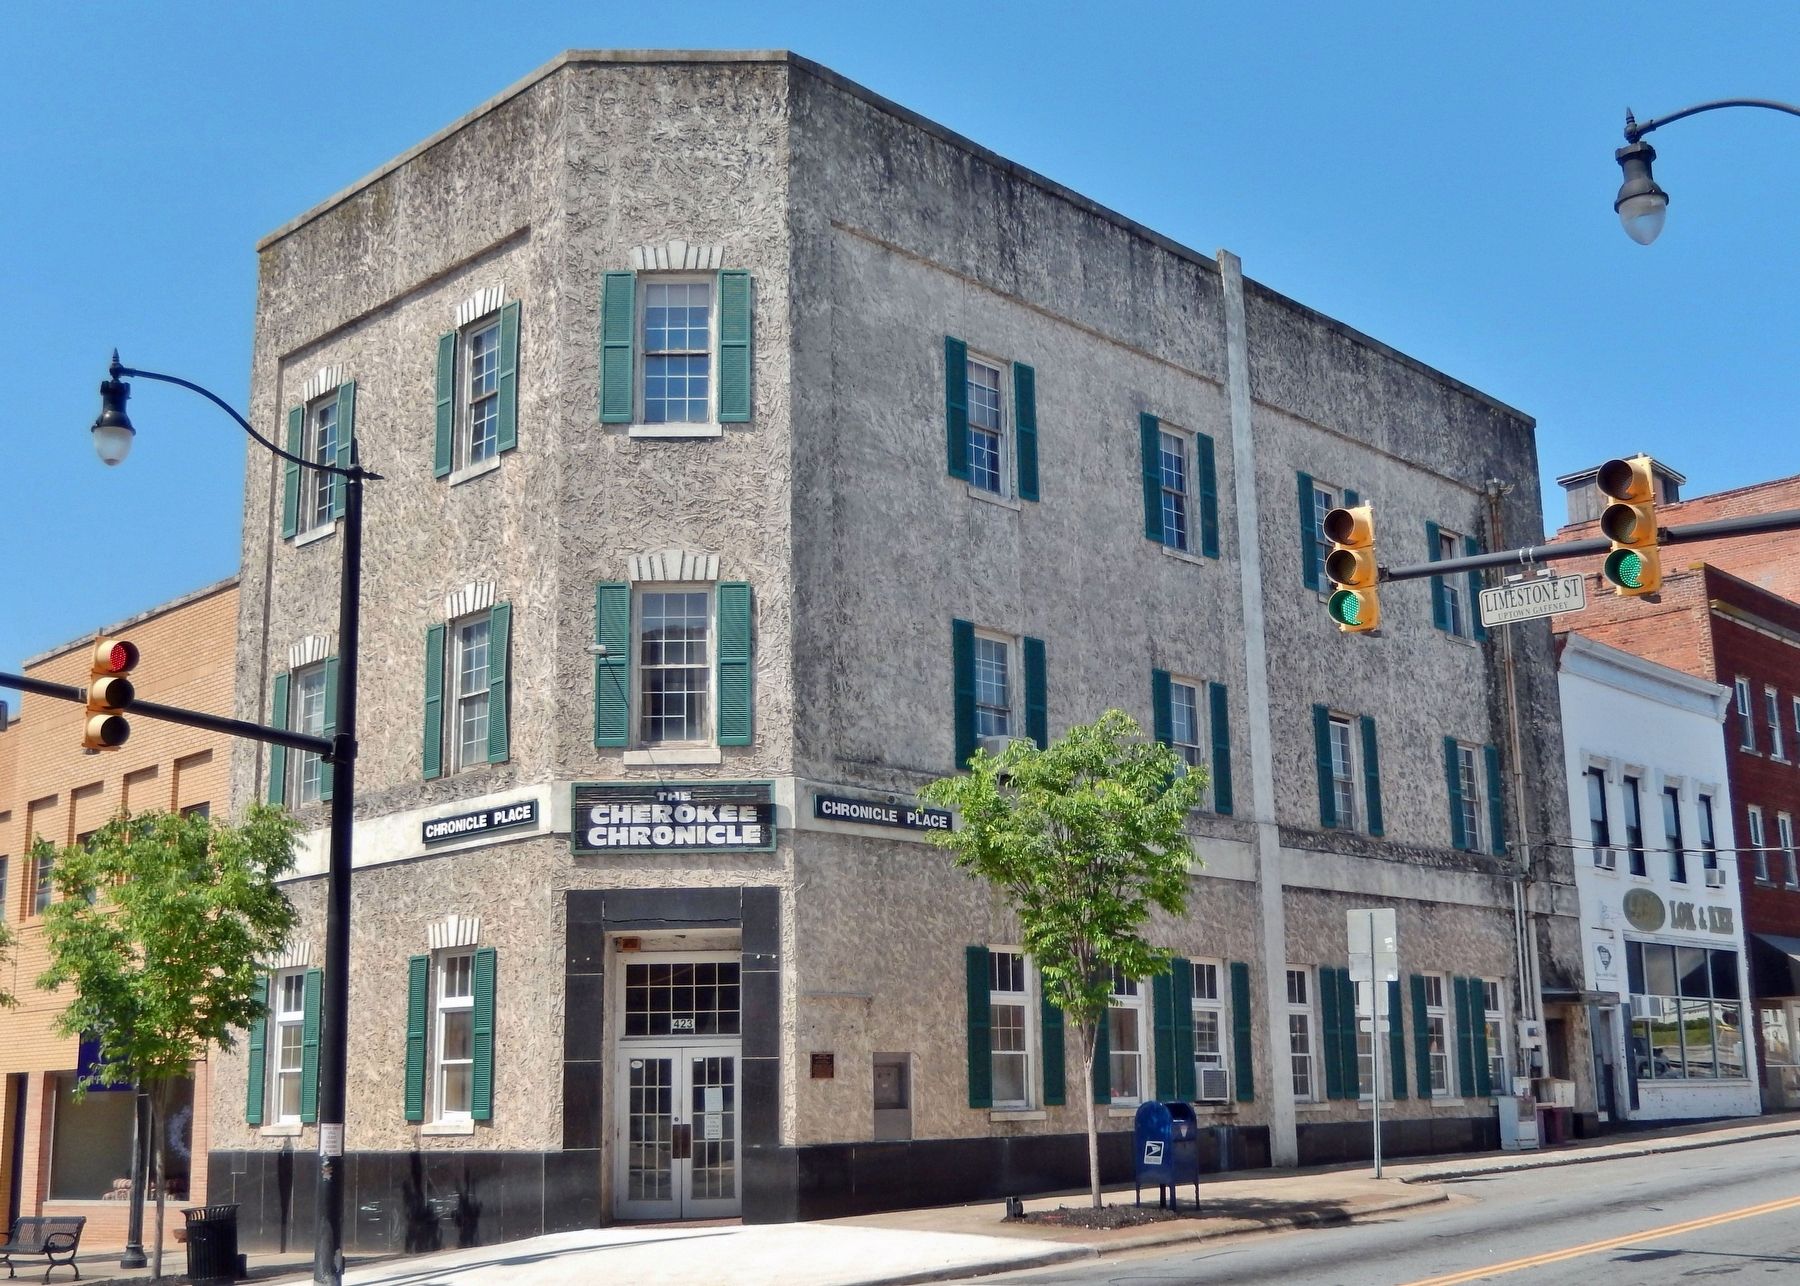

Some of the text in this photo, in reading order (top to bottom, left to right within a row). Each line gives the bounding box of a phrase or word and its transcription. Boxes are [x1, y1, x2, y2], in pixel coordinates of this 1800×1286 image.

[1484, 578, 1579, 612] LIMESTONE ST
[1497, 601, 1568, 621] UPTOWN GAFFNEY
[656, 791, 692, 802] THE
[425, 805, 532, 838] CHRONICLE PLACE
[590, 803, 758, 825] CHEROKEE
[821, 800, 948, 829] CHRONICLE PLACE
[587, 825, 762, 846] CHRONICLE
[673, 1019, 693, 1029] 423
